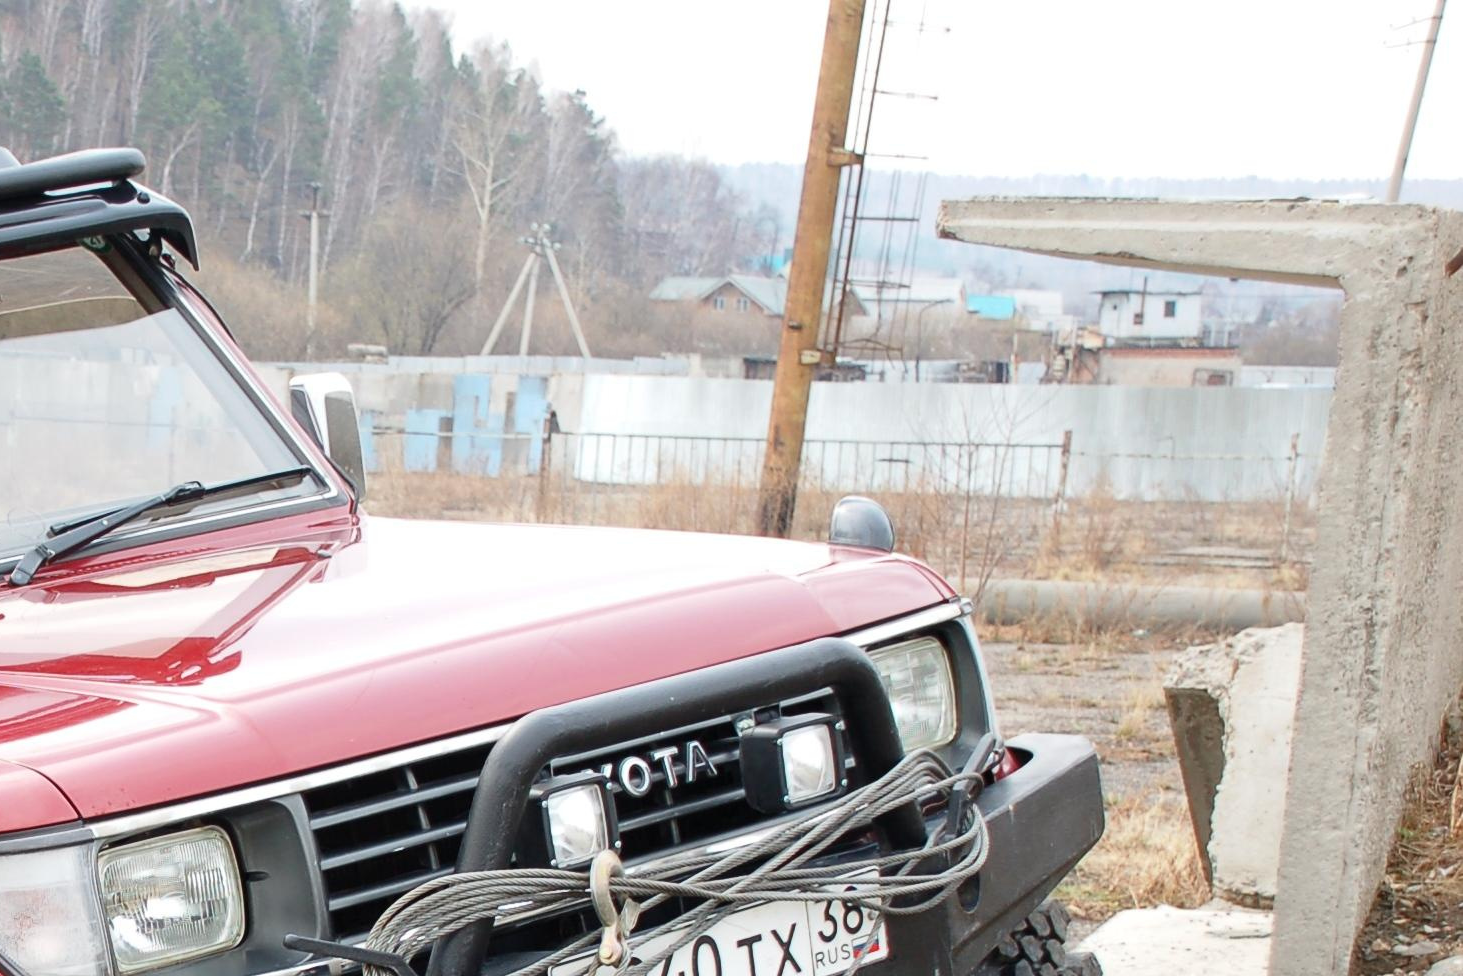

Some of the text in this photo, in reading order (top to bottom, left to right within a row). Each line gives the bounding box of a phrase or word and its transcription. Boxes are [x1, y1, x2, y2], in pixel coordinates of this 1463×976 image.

[600, 740, 719, 799] OTA
[817, 886, 864, 943] 38
[815, 943, 852, 969] RUS
